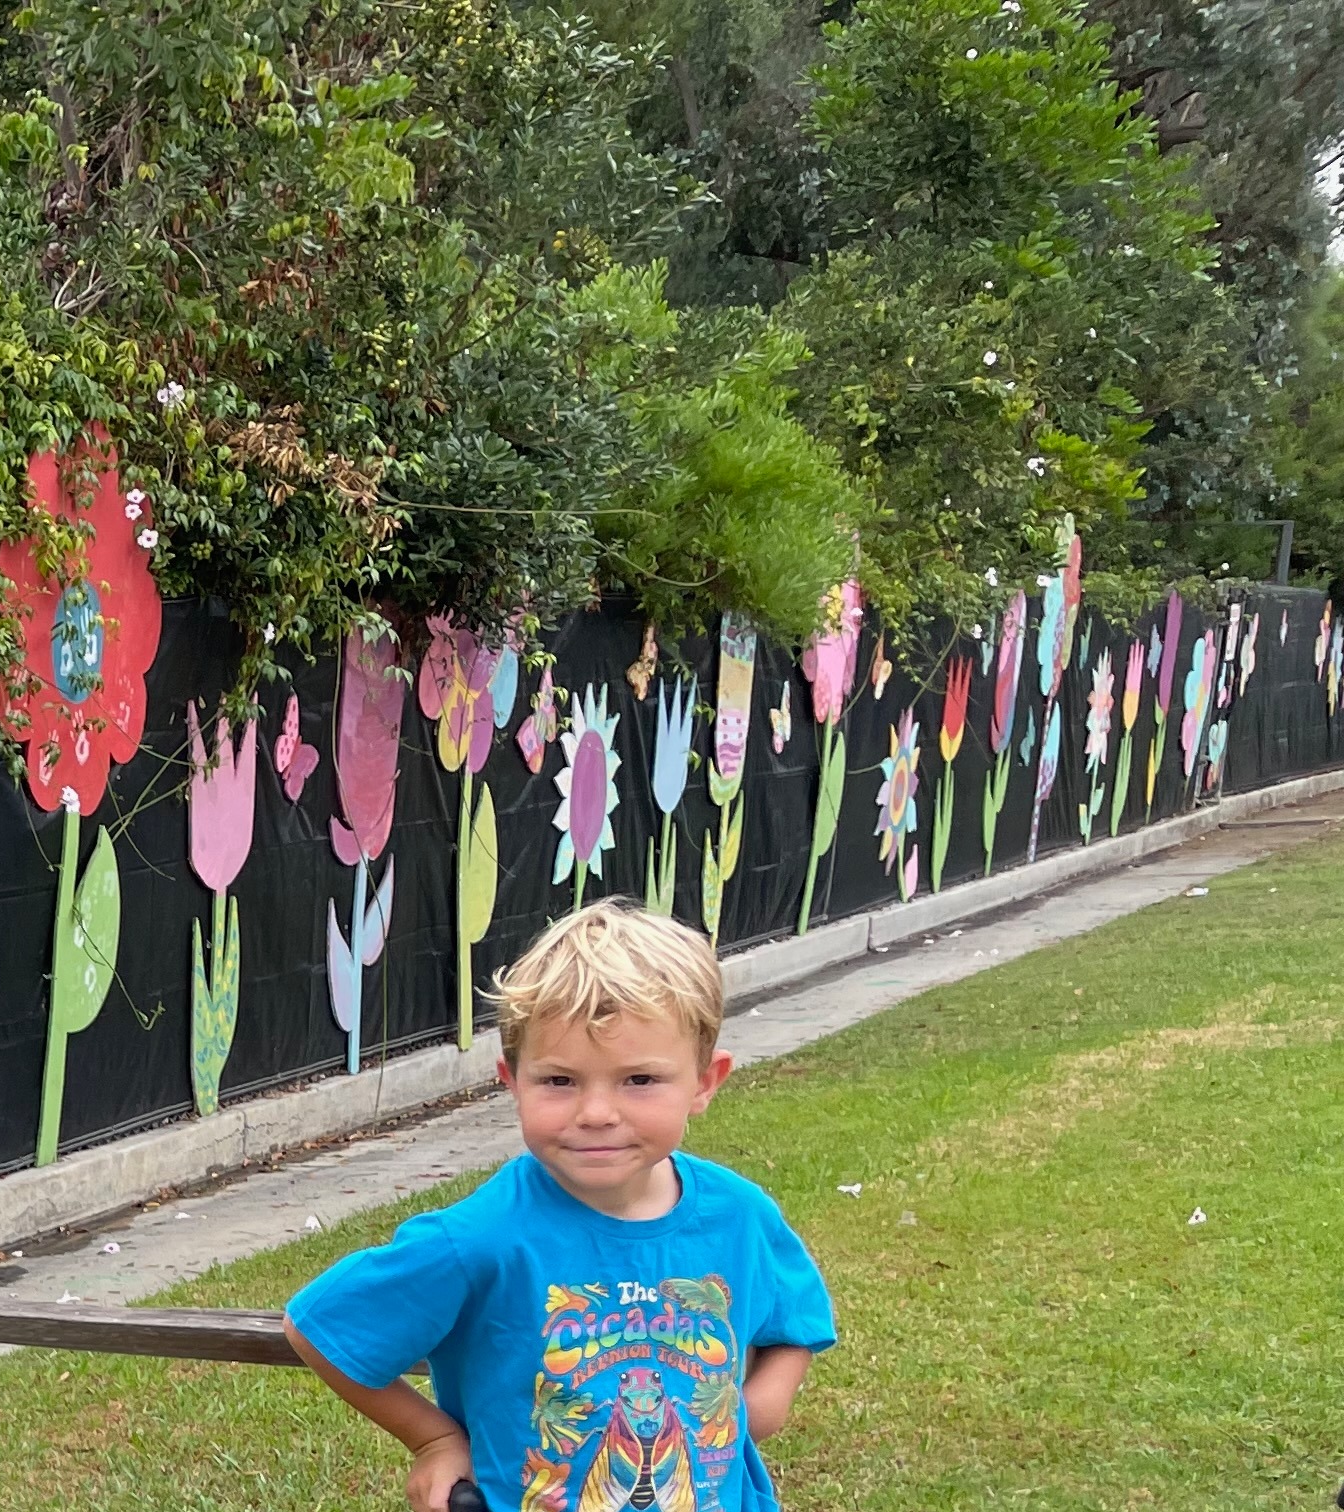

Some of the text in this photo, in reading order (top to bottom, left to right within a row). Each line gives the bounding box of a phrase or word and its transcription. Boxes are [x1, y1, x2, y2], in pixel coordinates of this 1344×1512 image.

[617, 1281, 658, 1306] The
[543, 1303, 728, 1375] Cicadas
[571, 1343, 707, 1390] REUNION TOUR
